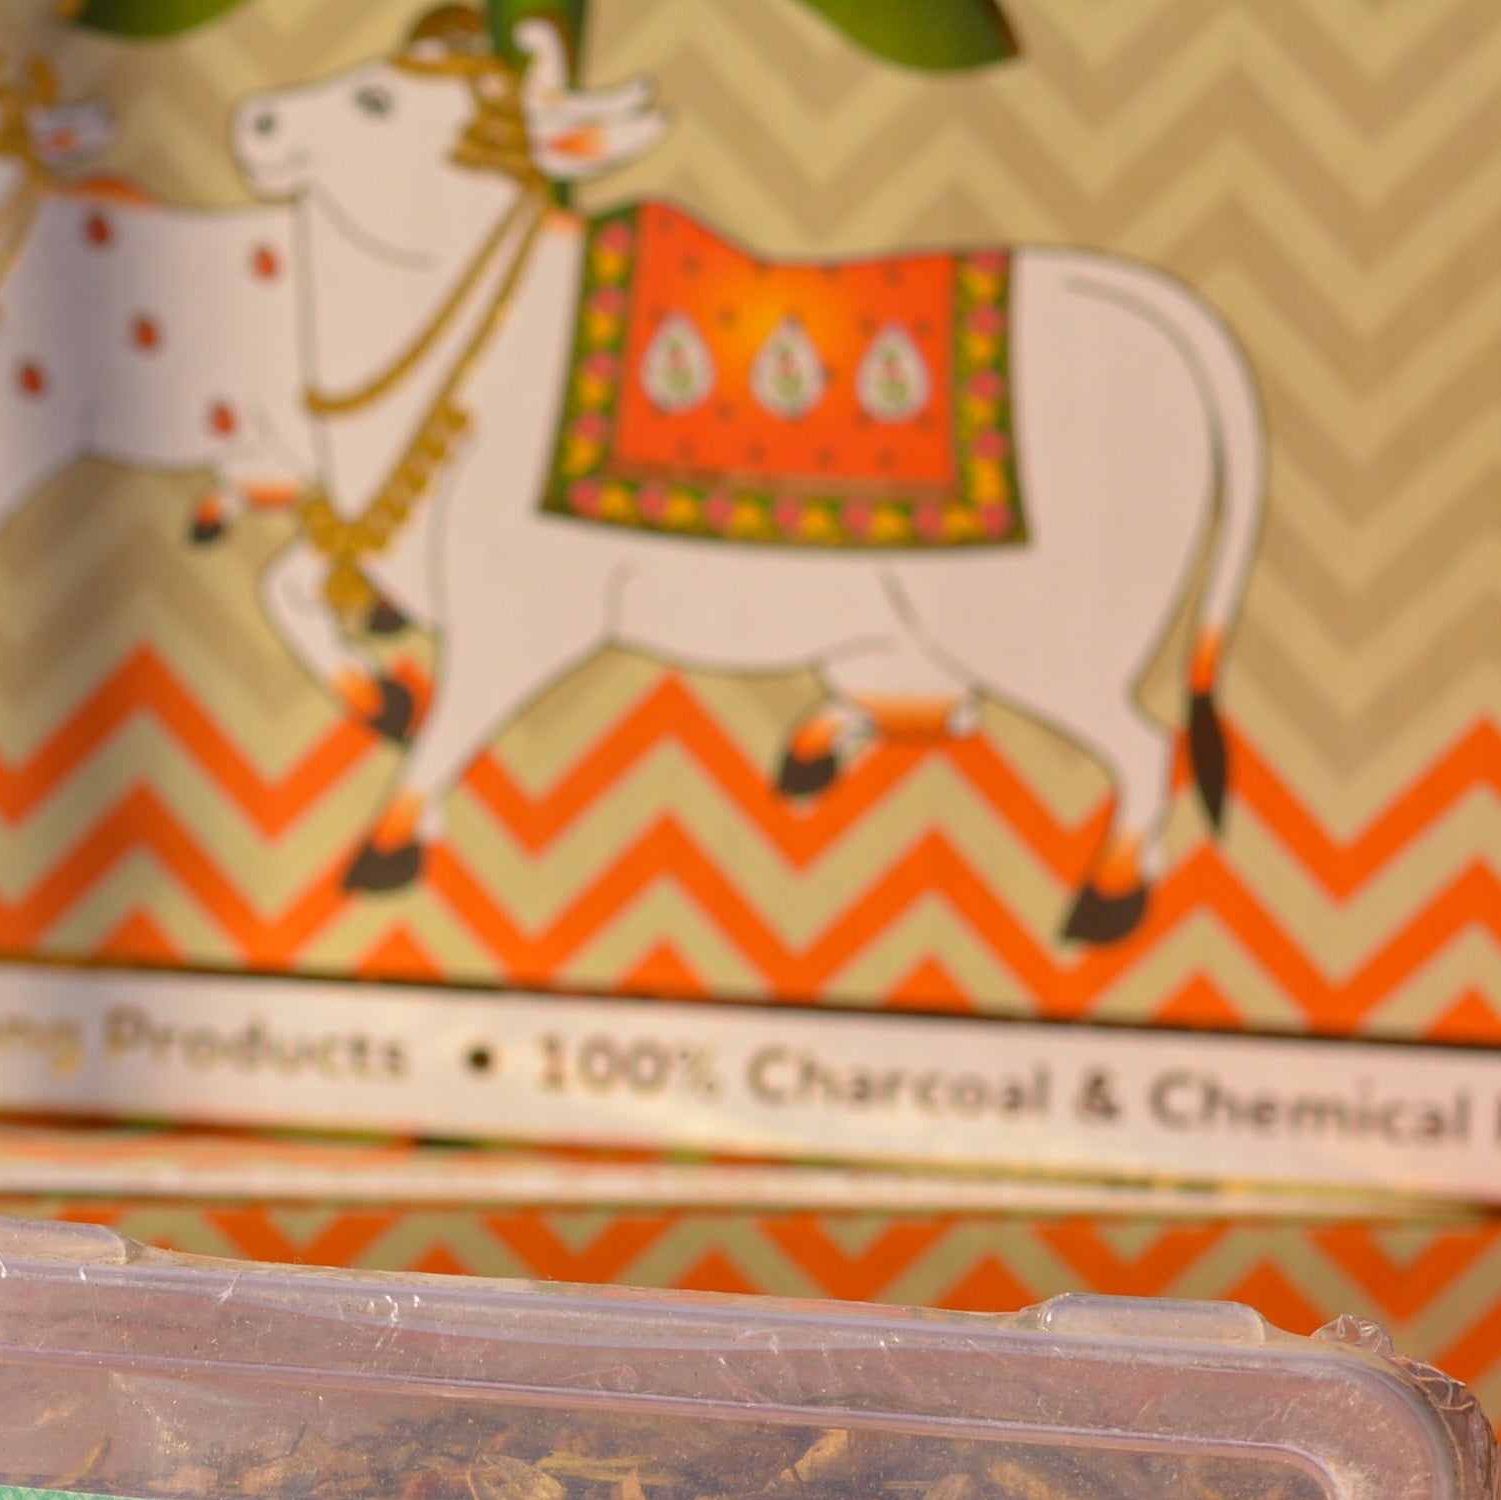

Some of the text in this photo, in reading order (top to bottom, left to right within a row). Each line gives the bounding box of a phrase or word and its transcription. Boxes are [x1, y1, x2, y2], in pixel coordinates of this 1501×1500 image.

[108, 1007, 406, 1080] Products
[537, 1032, 719, 1101] 100%
[747, 1045, 1049, 1118] Charcoal
[1074, 1075, 1120, 1122] &
[1150, 1070, 1470, 1146] Chemical
